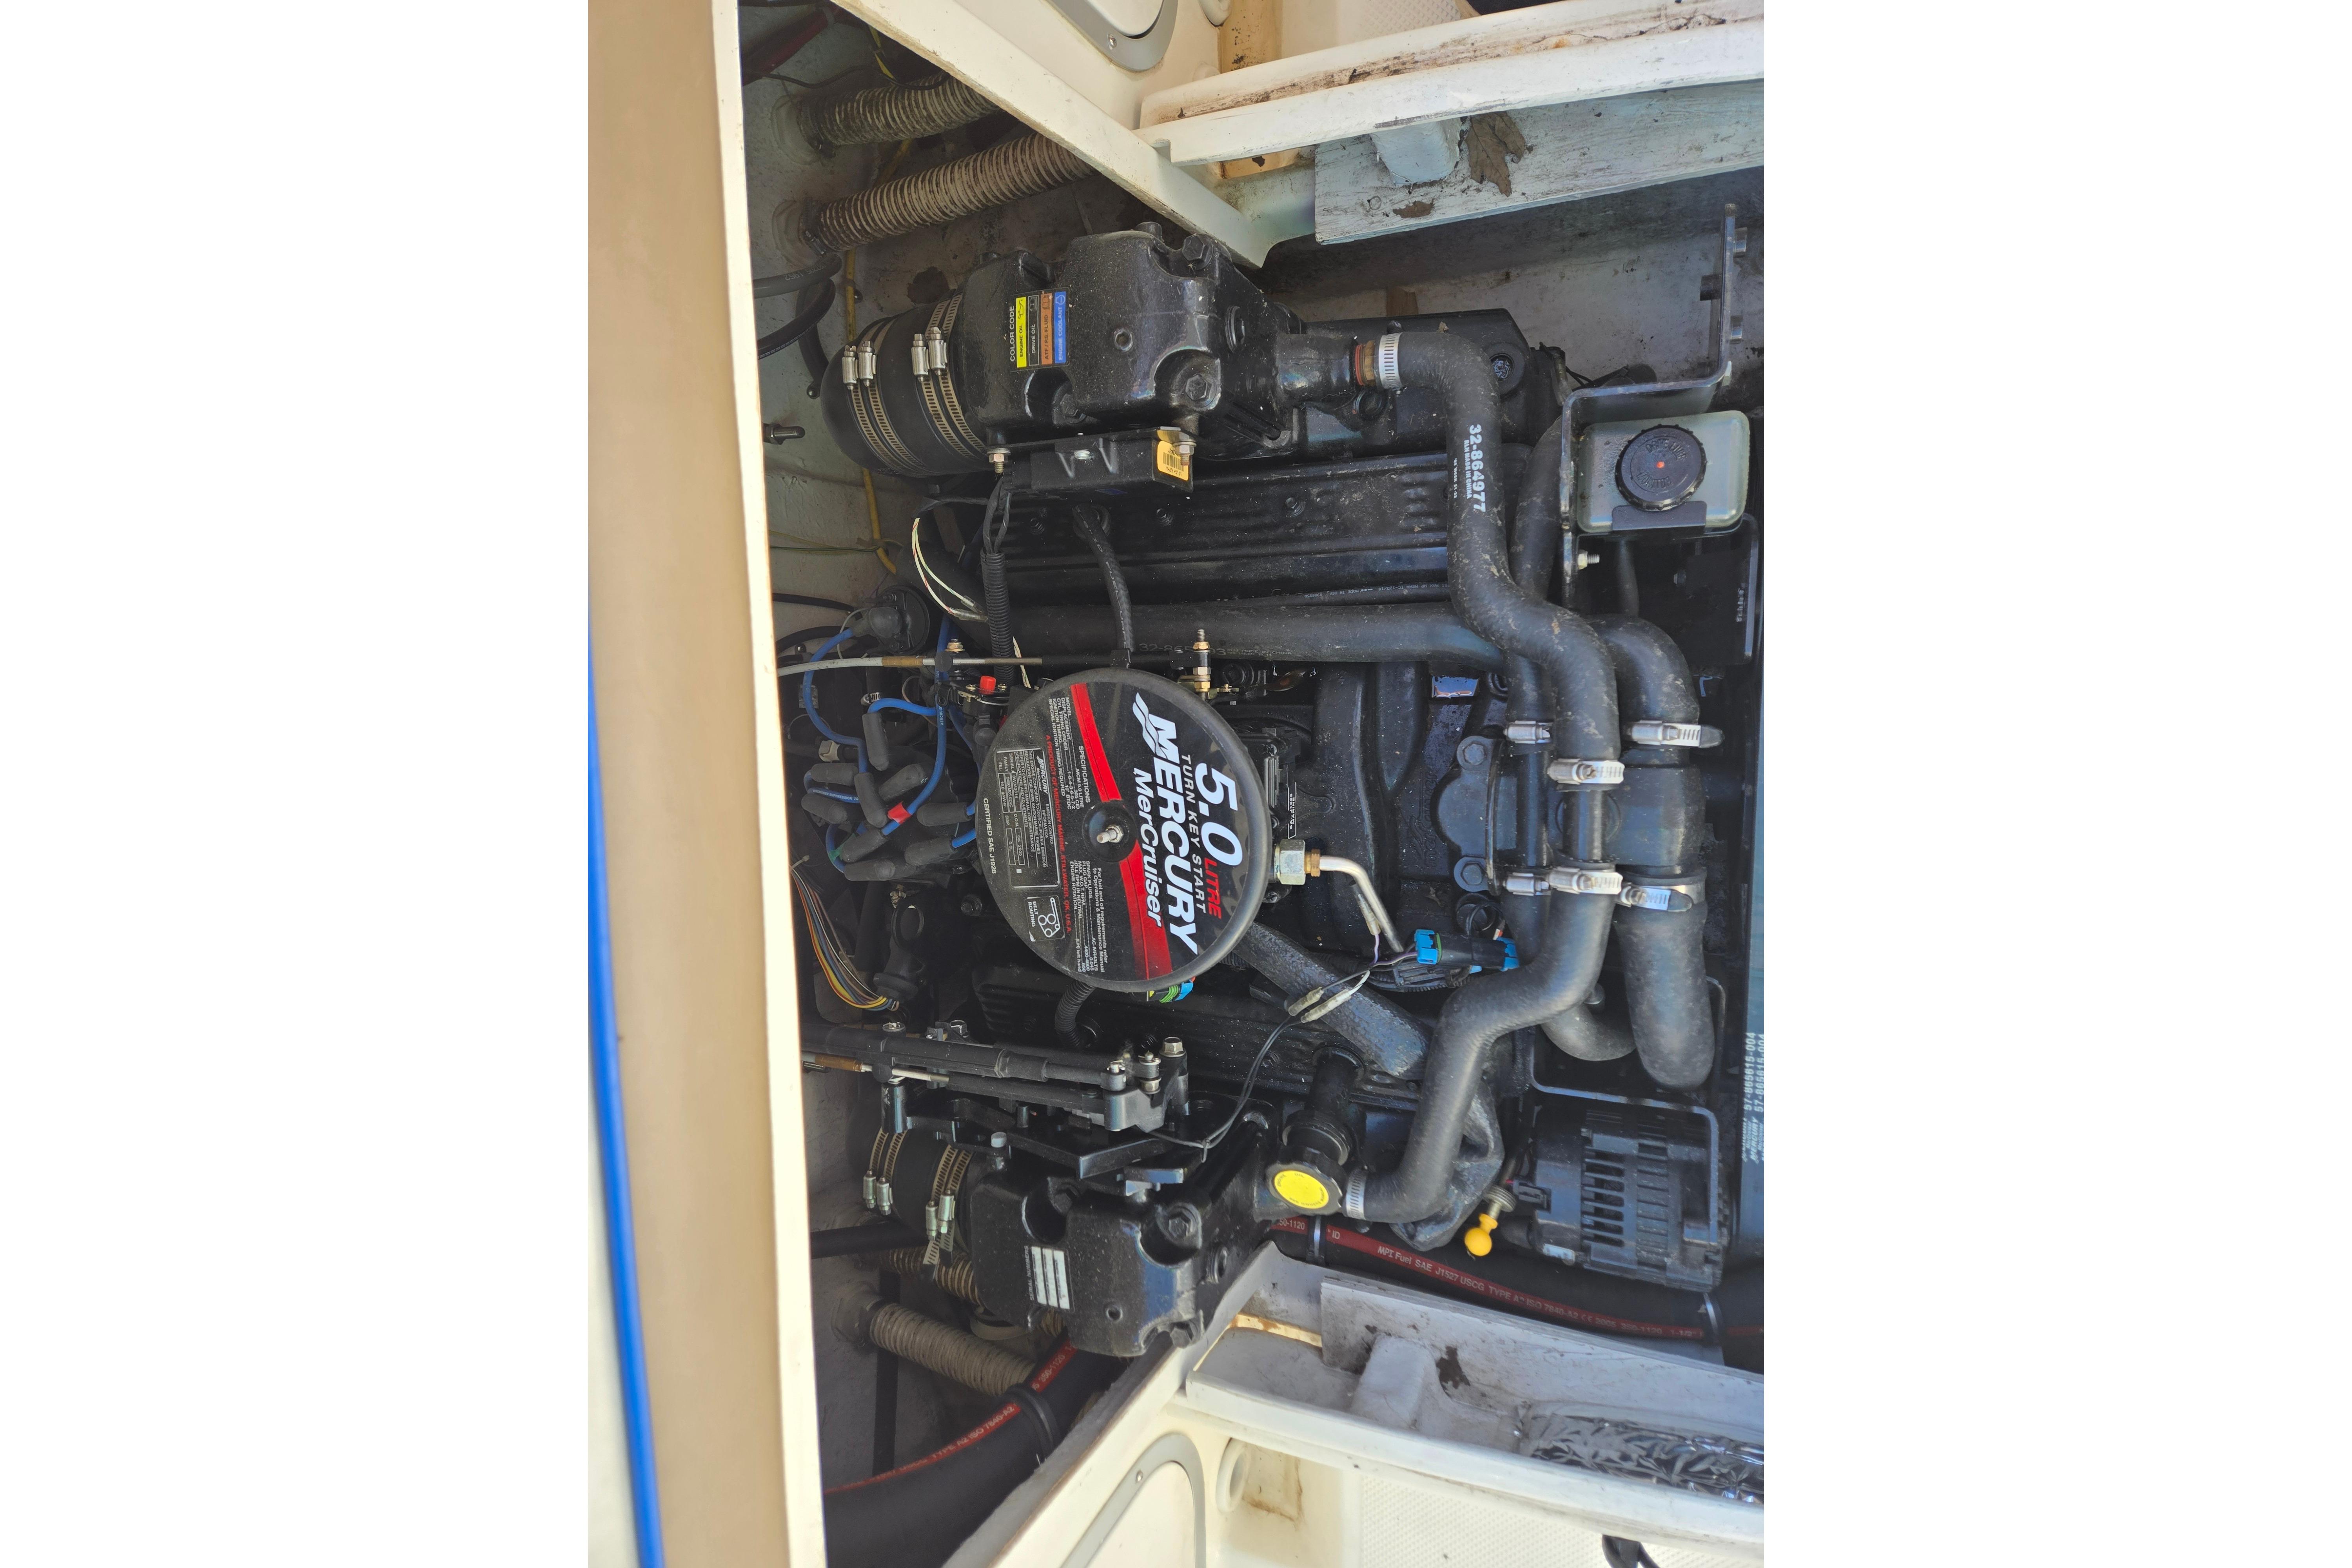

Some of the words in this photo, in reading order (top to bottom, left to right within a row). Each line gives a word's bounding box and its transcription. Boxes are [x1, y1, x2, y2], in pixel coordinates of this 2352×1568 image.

[1469, 424, 1486, 512] 32-864977
[1061, 697, 1070, 740] DISPLACEMENT
[1036, 756, 1048, 794] MERCURY
[1047, 741, 1056, 775] PRODUCT
[1053, 777, 1058, 787] OF
[1079, 746, 1091, 803] SPECIFICATIONS
[1181, 754, 1196, 807] TURN
[1053, 788, 1063, 822] MERCURY
[1067, 771, 1076, 809] 1-8-4-3-6-5-7-2
[984, 798, 993, 836] CERTIFIED
[1147, 710, 1198, 955] MERCURY
[1188, 811, 1201, 848] KEY
[1195, 763, 1243, 866] 5.0
[1133, 768, 1163, 927] MerCruiser
[1192, 853, 1206, 913] START
[1204, 857, 1222, 919] LITRE
[1028, 902, 1036, 927] ROUTING
[1743, 1032, 1756, 1111] 57-865615-004
[1332, 1230, 1341, 1240] ID
[1377, 1246, 1394, 1258] MPI
[1395, 1252, 1412, 1264] Fuel
[1415, 1259, 1433, 1272] SAE
[1436, 1267, 1459, 1281] J1527
[1460, 1276, 1485, 1291] USCG
[1489, 1285, 1512, 1300] TYPE
[1526, 1298, 1542, 1309] ISO
[1544, 1303, 1579, 1319] 7840-A2
[1595, 1318, 1616, 1327] 2005
